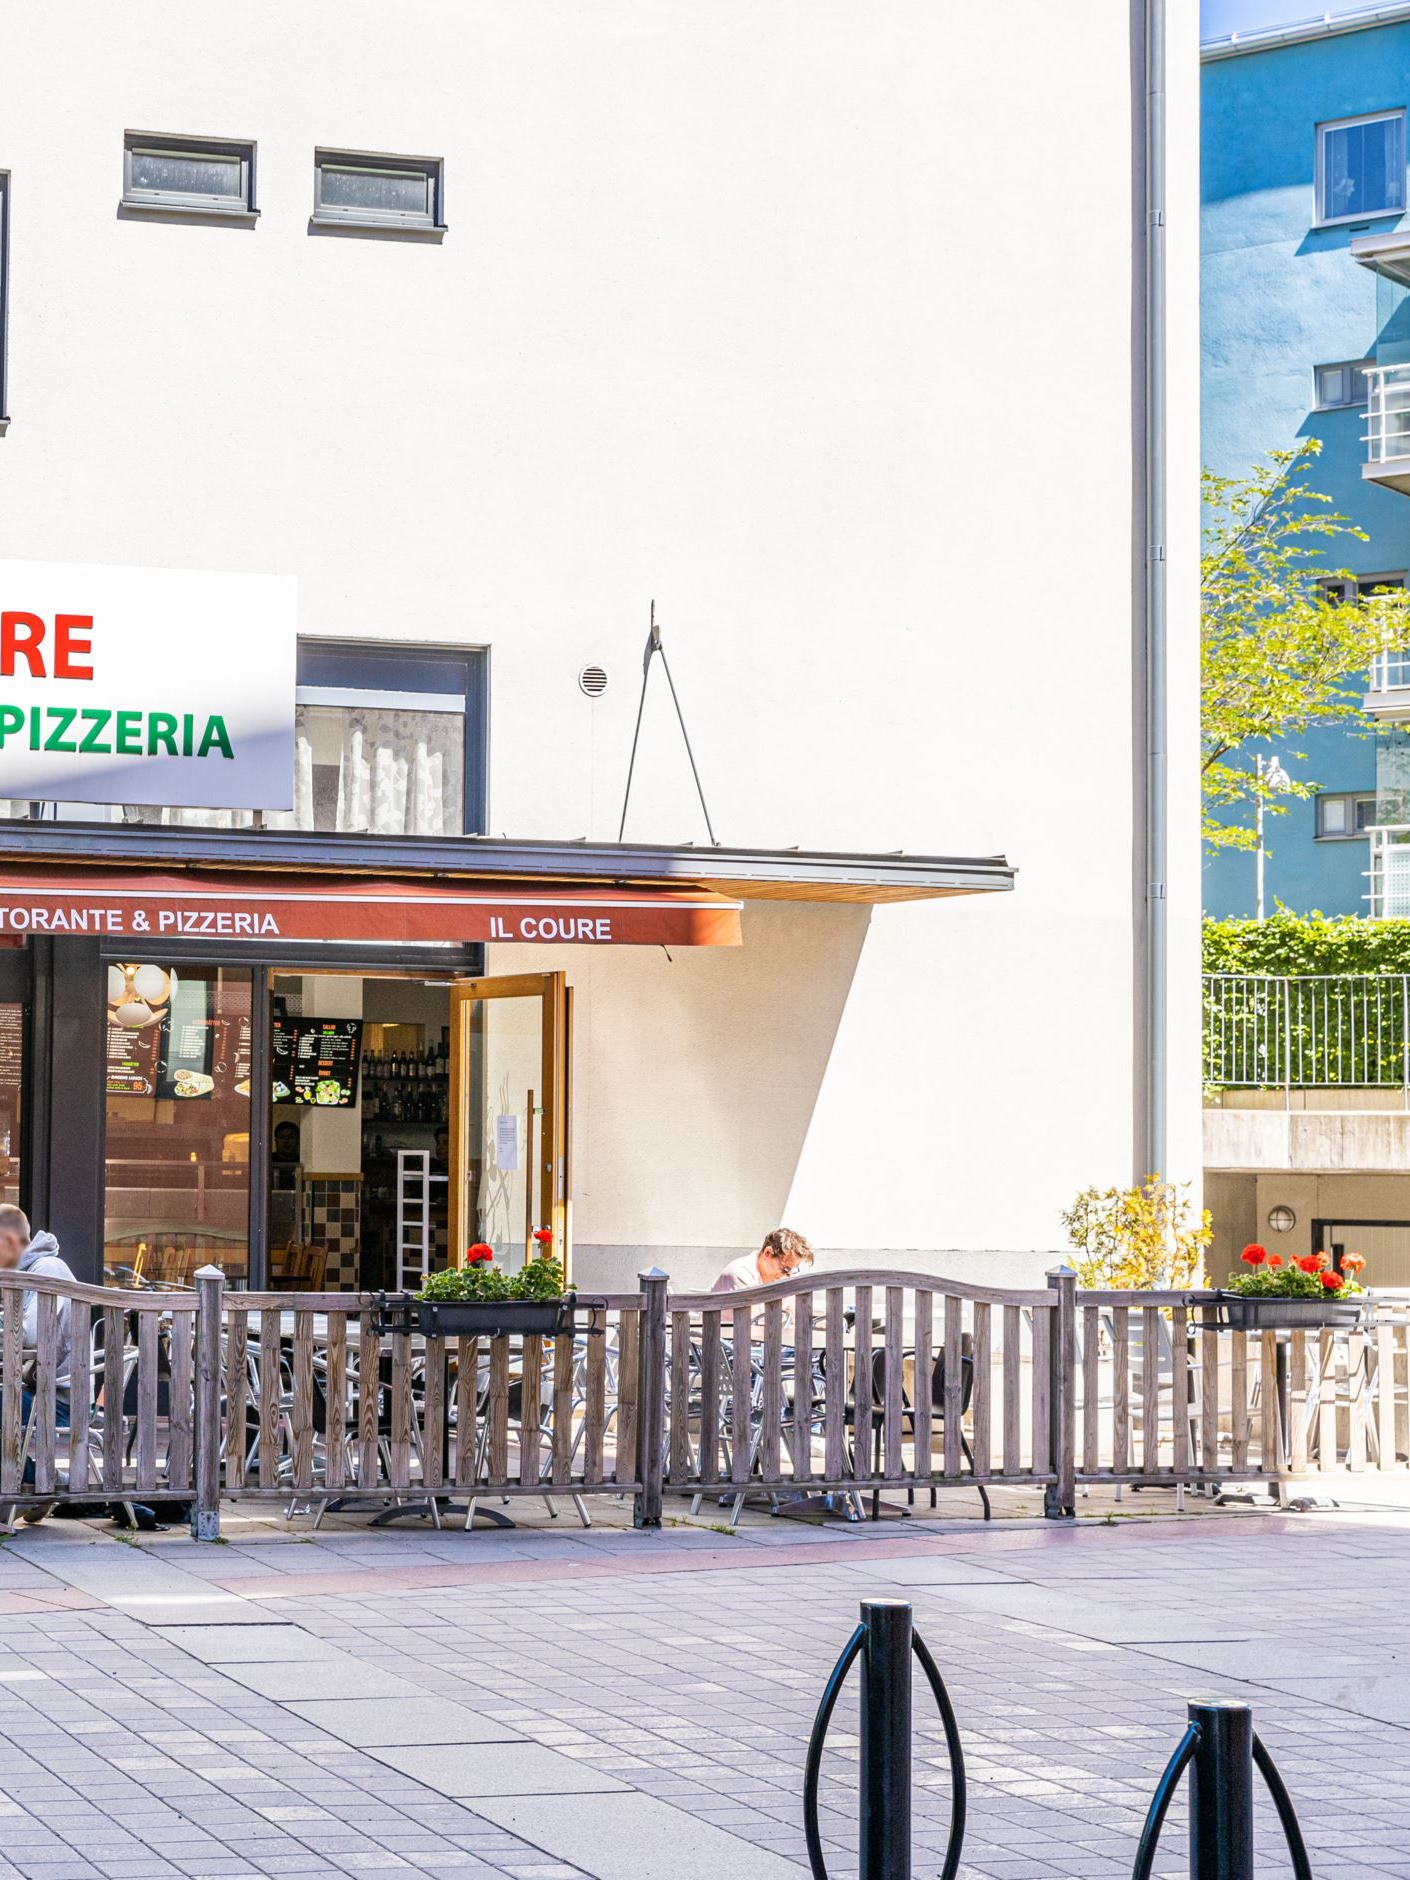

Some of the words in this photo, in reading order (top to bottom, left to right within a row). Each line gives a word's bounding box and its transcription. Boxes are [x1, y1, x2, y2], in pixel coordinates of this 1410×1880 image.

[132, 910, 150, 932] &
[158, 911, 280, 935] PIZZERIA
[490, 916, 513, 938] IL
[520, 918, 612, 940] COURE
